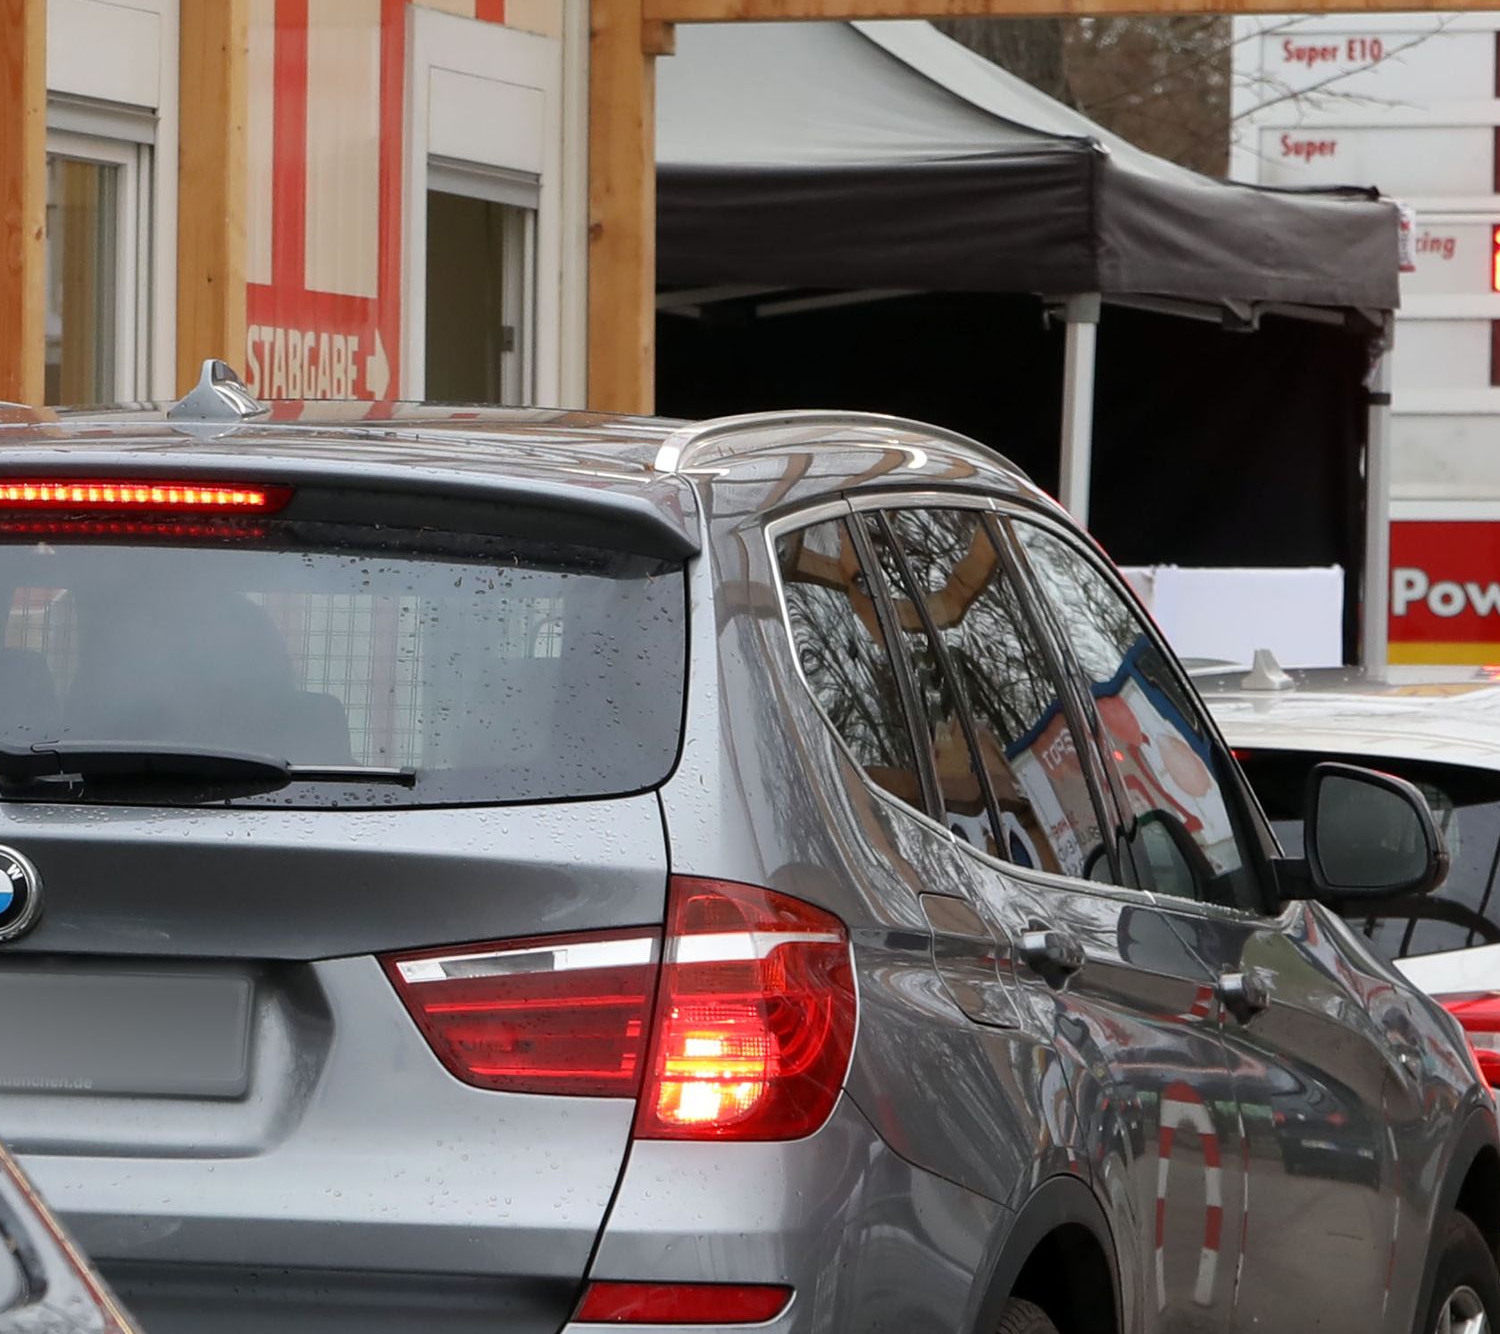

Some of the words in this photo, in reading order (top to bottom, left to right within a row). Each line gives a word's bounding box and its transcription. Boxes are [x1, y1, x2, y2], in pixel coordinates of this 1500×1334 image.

[1281, 38, 1338, 65] Super
[1346, 37, 1383, 62] E10
[1279, 133, 1337, 160] Super
